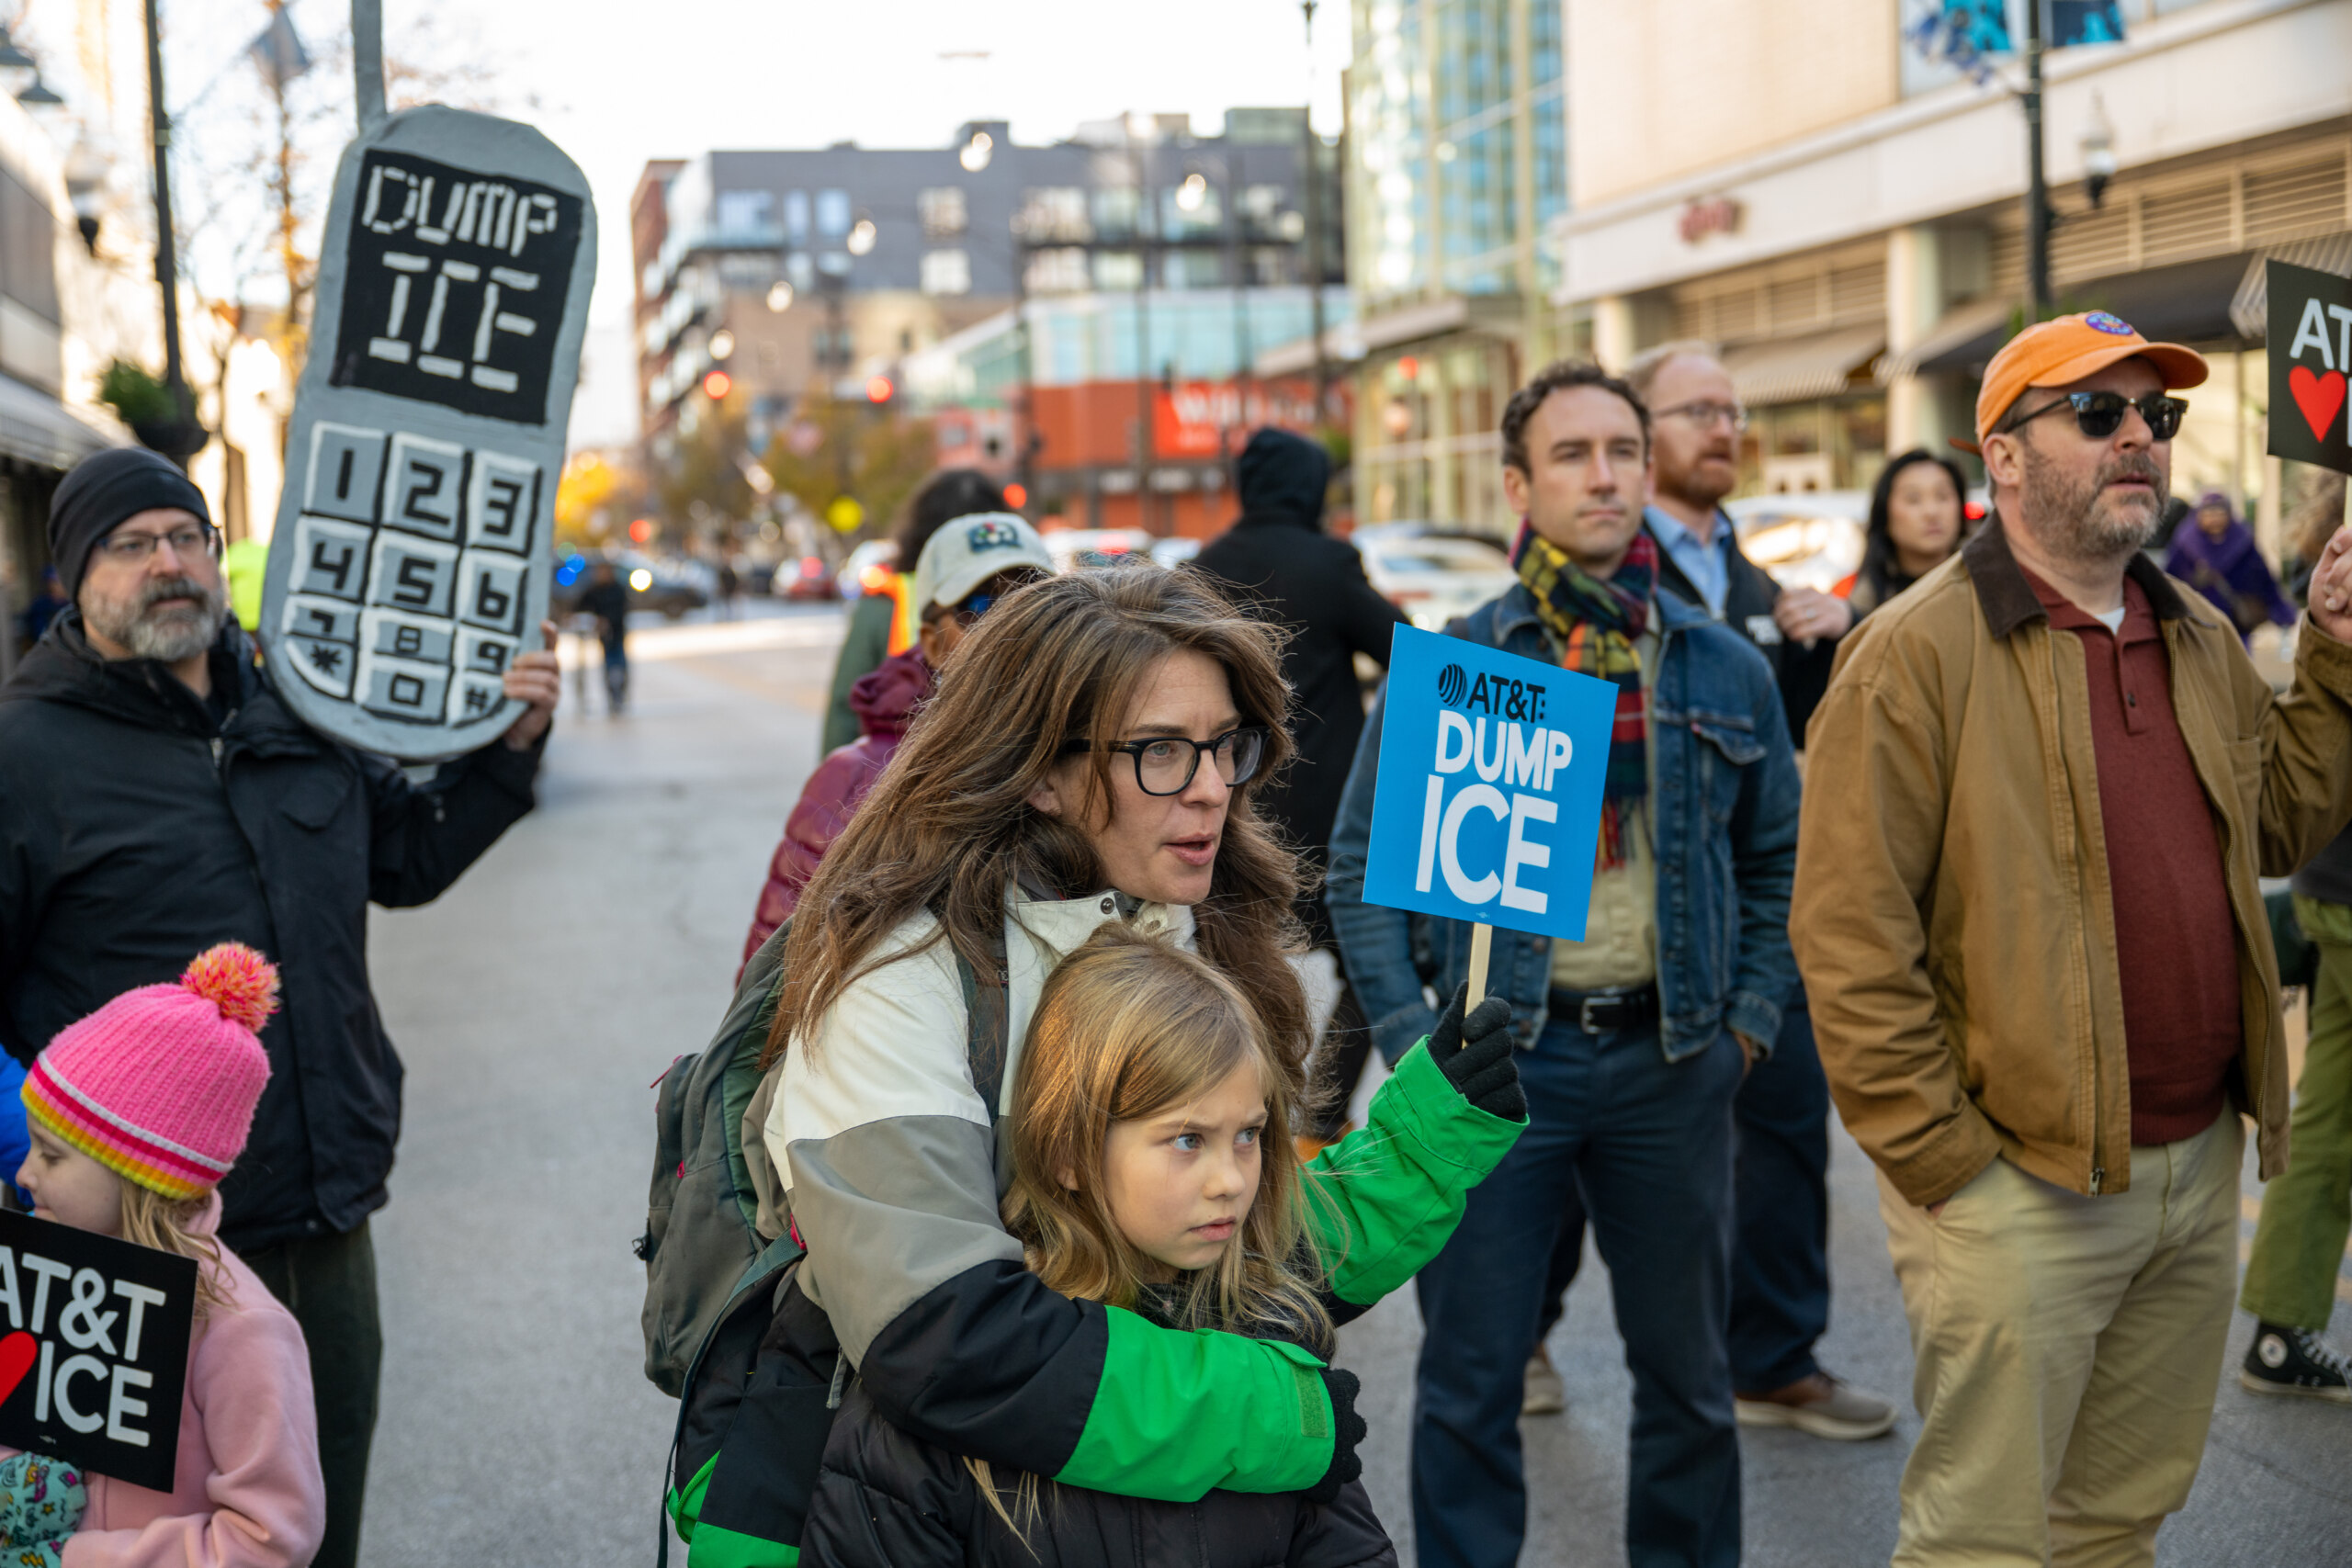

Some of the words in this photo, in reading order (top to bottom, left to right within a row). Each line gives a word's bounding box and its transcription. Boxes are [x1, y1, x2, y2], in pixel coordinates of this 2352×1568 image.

[361, 165, 558, 257] DUMP
[368, 251, 540, 393] ICE
[336, 448, 355, 501] 1
[403, 460, 450, 526] 2
[482, 478, 522, 536] 3
[311, 541, 354, 590] 4
[393, 556, 437, 605] 5
[476, 571, 510, 619] 6
[310, 610, 334, 634] 7
[396, 625, 423, 653] 8
[477, 641, 506, 668] 9
[389, 671, 424, 707] 0
[1466, 671, 1546, 723] AT&T:
[1434, 709, 1573, 792] DUMP
[1416, 773, 1558, 915] ICE
[34, 1340, 153, 1447] ICE
